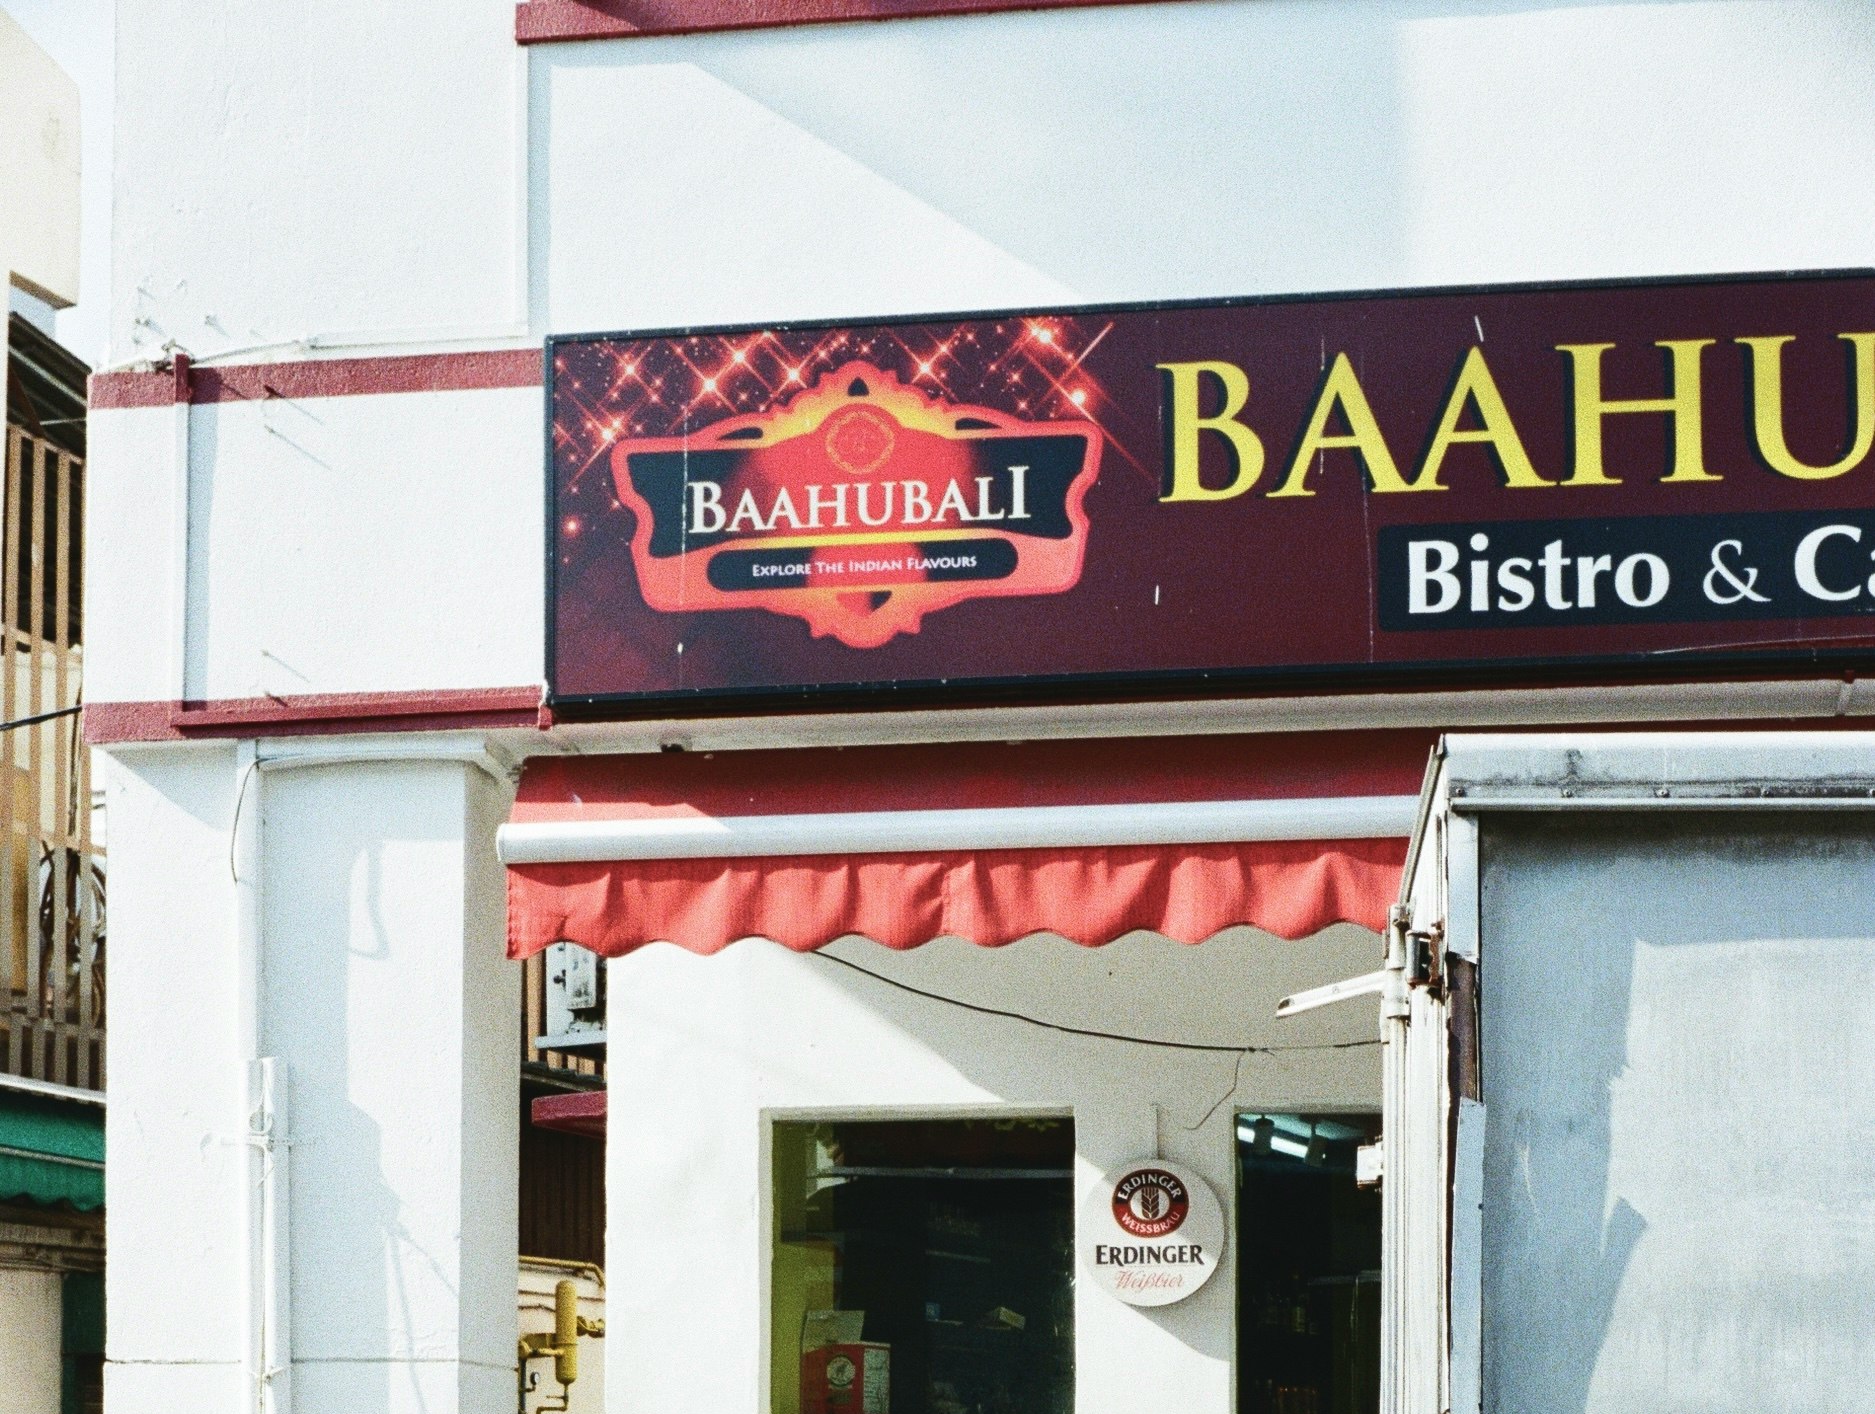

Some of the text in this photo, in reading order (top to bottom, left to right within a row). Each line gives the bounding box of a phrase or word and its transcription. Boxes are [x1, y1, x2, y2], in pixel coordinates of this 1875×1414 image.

[1156, 332, 1875, 503] BAAHU
[687, 465, 1031, 535] BAAHUBALI
[752, 556, 977, 577] EXPLORE THE INDIAN FLAVOURS
[1408, 524, 1875, 615] Bistro & C
[1117, 1173, 1182, 1200] ERDINGER
[1095, 1244, 1205, 1267] ERDINGER
